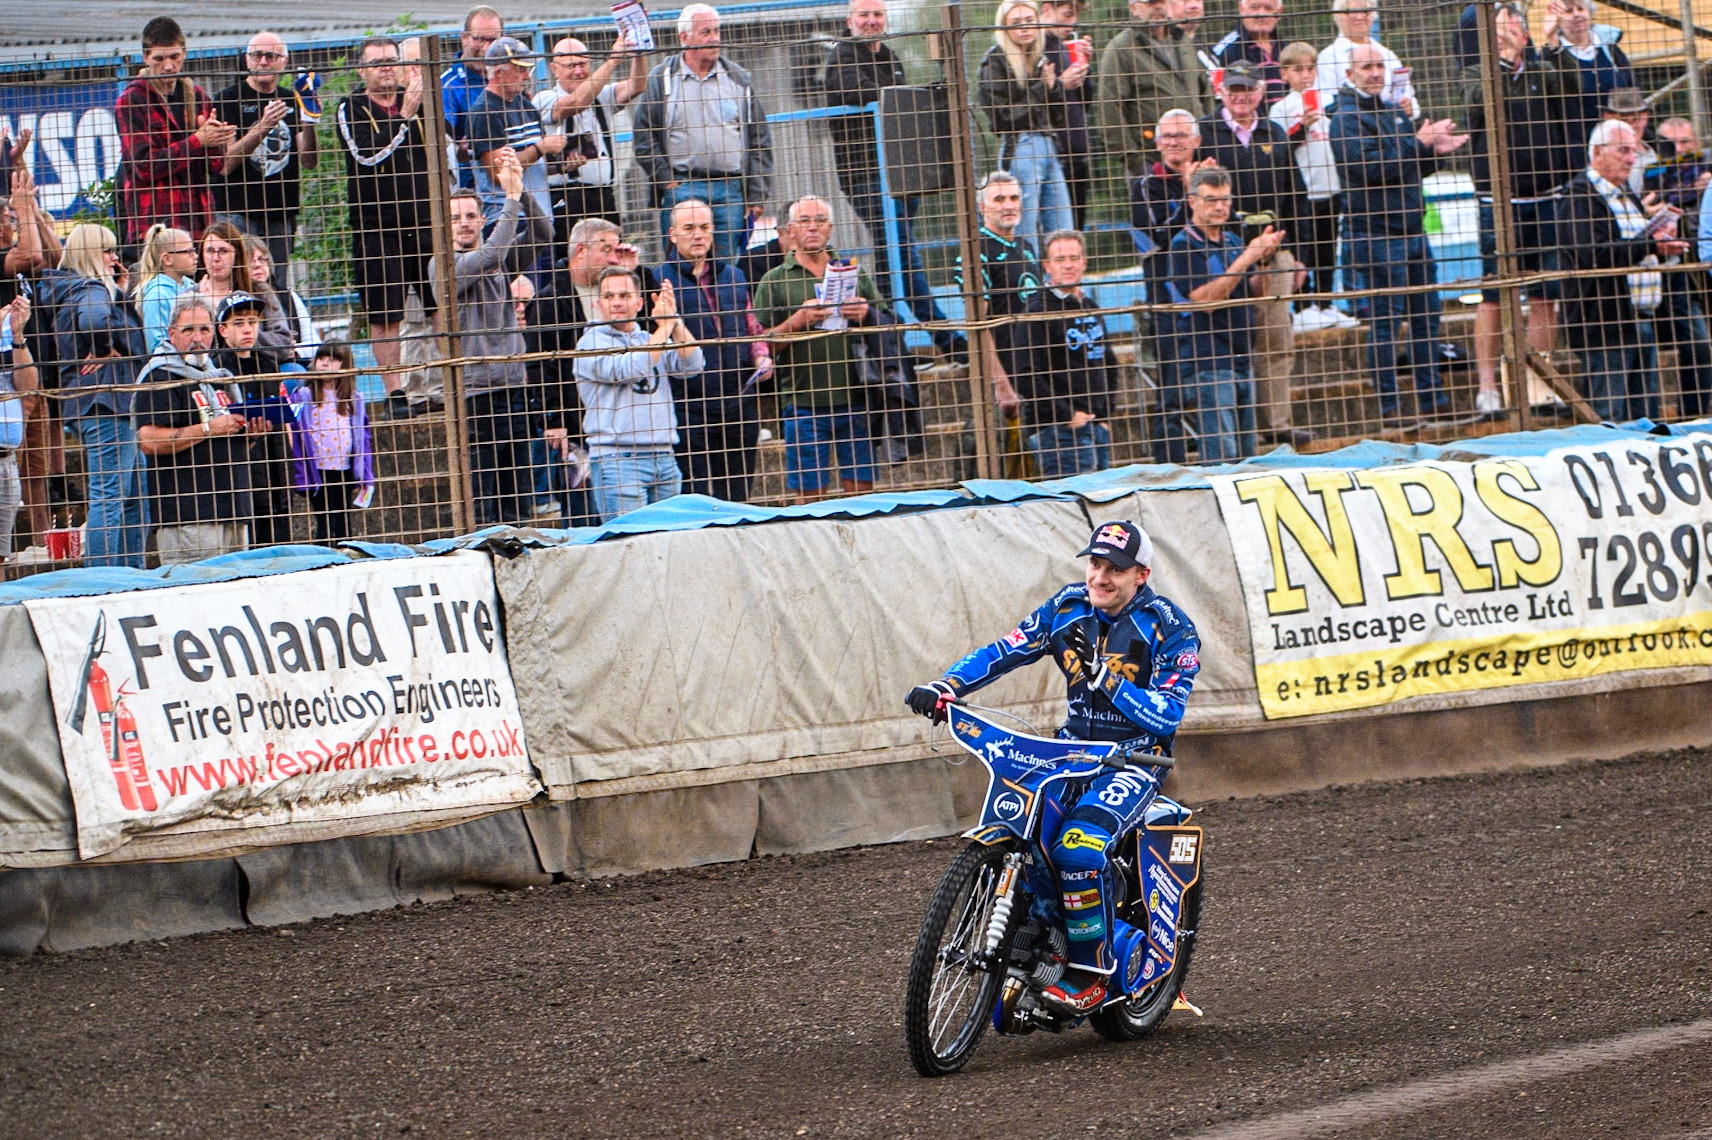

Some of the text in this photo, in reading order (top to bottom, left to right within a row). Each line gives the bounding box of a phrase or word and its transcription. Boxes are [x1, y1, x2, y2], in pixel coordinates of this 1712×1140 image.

[1235, 460, 1563, 616] NRS
[1435, 603, 1519, 628] Centre
[1527, 591, 1574, 620] Ltd
[119, 582, 495, 690] Fenland Fire
[1277, 677, 1301, 701] e:
[162, 673, 501, 743] Fire Protection Engineers
[1134, 709, 1163, 729] Tankers
[157, 719, 525, 798] www.fenlandfire.co.uk
[998, 800, 1019, 812] ATPI
[1168, 835, 1198, 863] 505
[1068, 922, 1101, 936] MOTOREX
